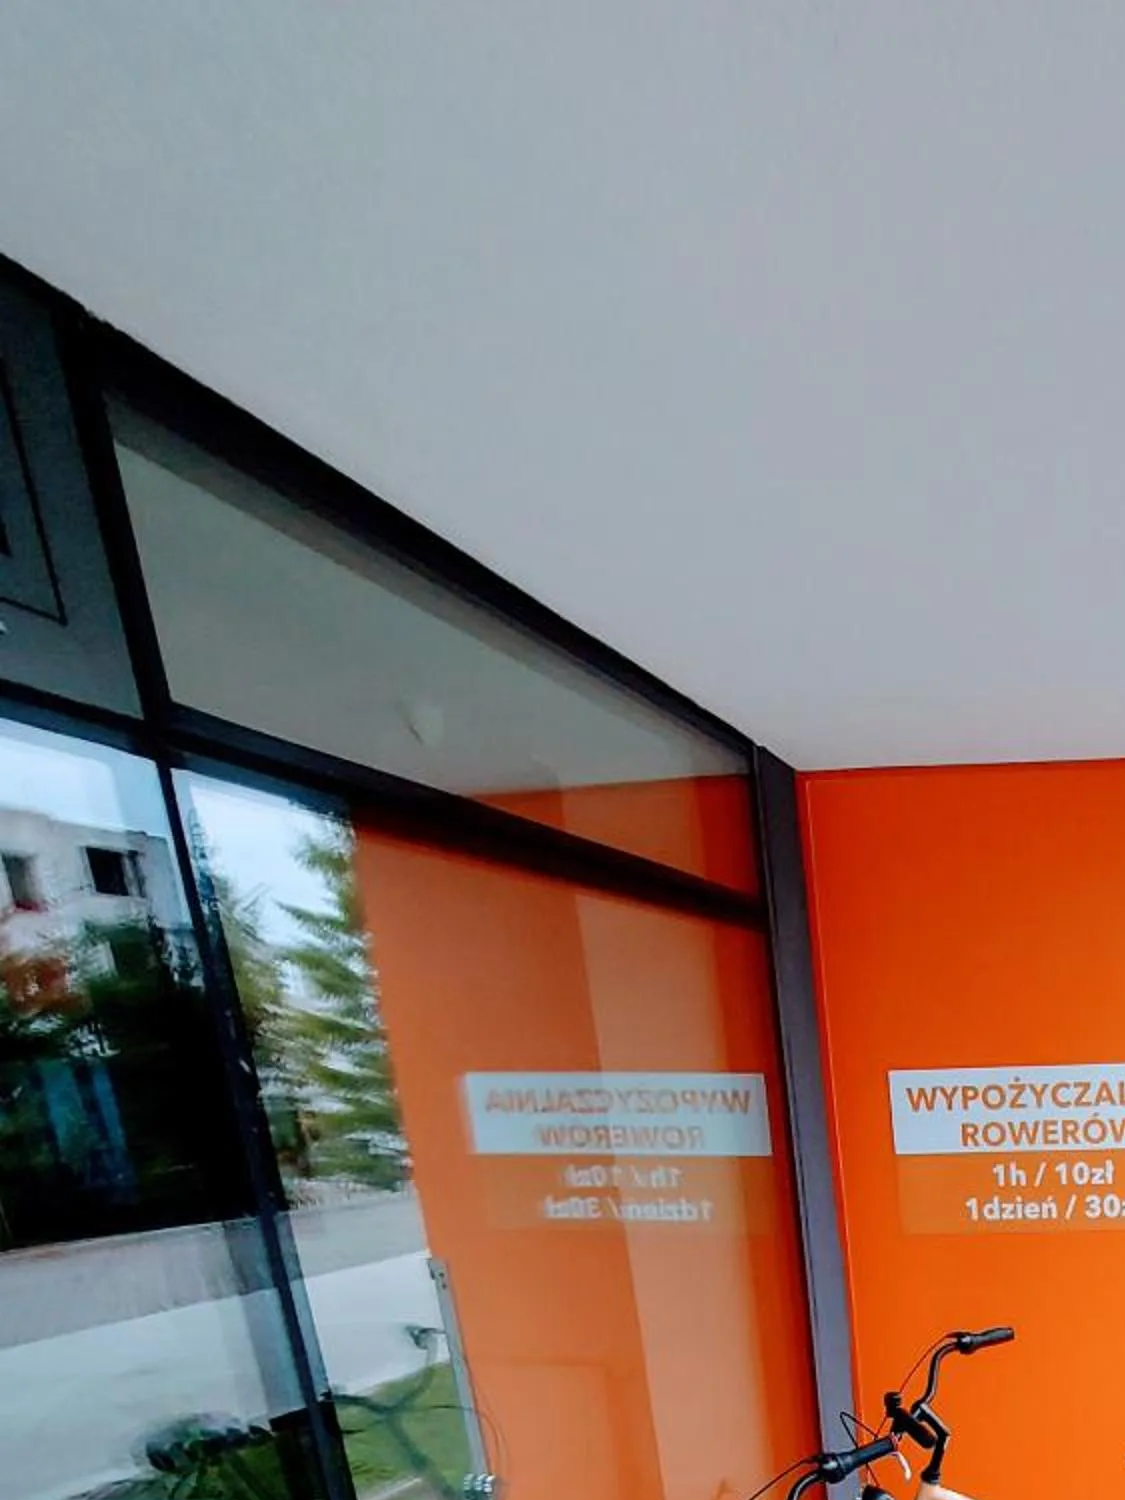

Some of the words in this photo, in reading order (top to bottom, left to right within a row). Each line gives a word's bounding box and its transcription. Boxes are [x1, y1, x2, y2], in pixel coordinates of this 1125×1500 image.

[992, 1161, 1027, 1187] 1h
[1033, 1161, 1047, 1187] /
[1055, 1159, 1115, 1186] 10zł
[965, 1194, 1058, 1221] 1dzień
[1065, 1195, 1077, 1221] /
